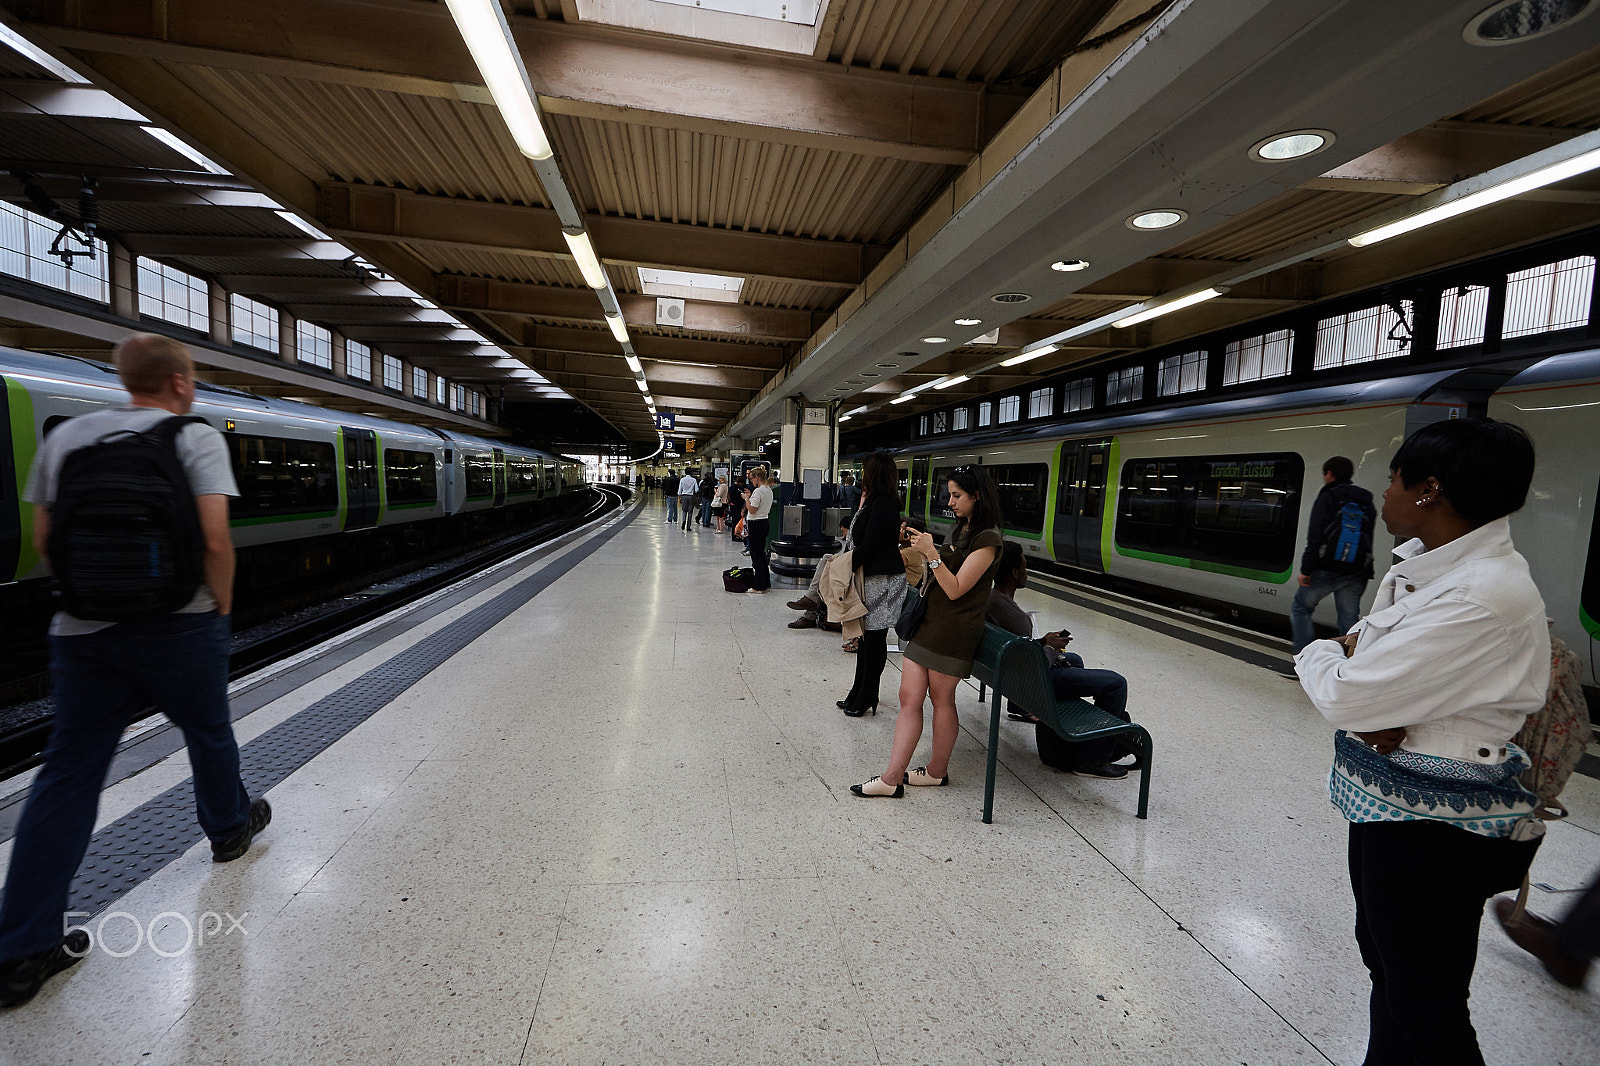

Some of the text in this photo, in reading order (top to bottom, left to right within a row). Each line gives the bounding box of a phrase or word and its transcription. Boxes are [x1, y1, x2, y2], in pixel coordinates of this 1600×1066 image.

[569, 66, 614, 80] ENGLAND
[1211, 462, 1275, 477] London Euston
[1258, 586, 1278, 597] 61447
